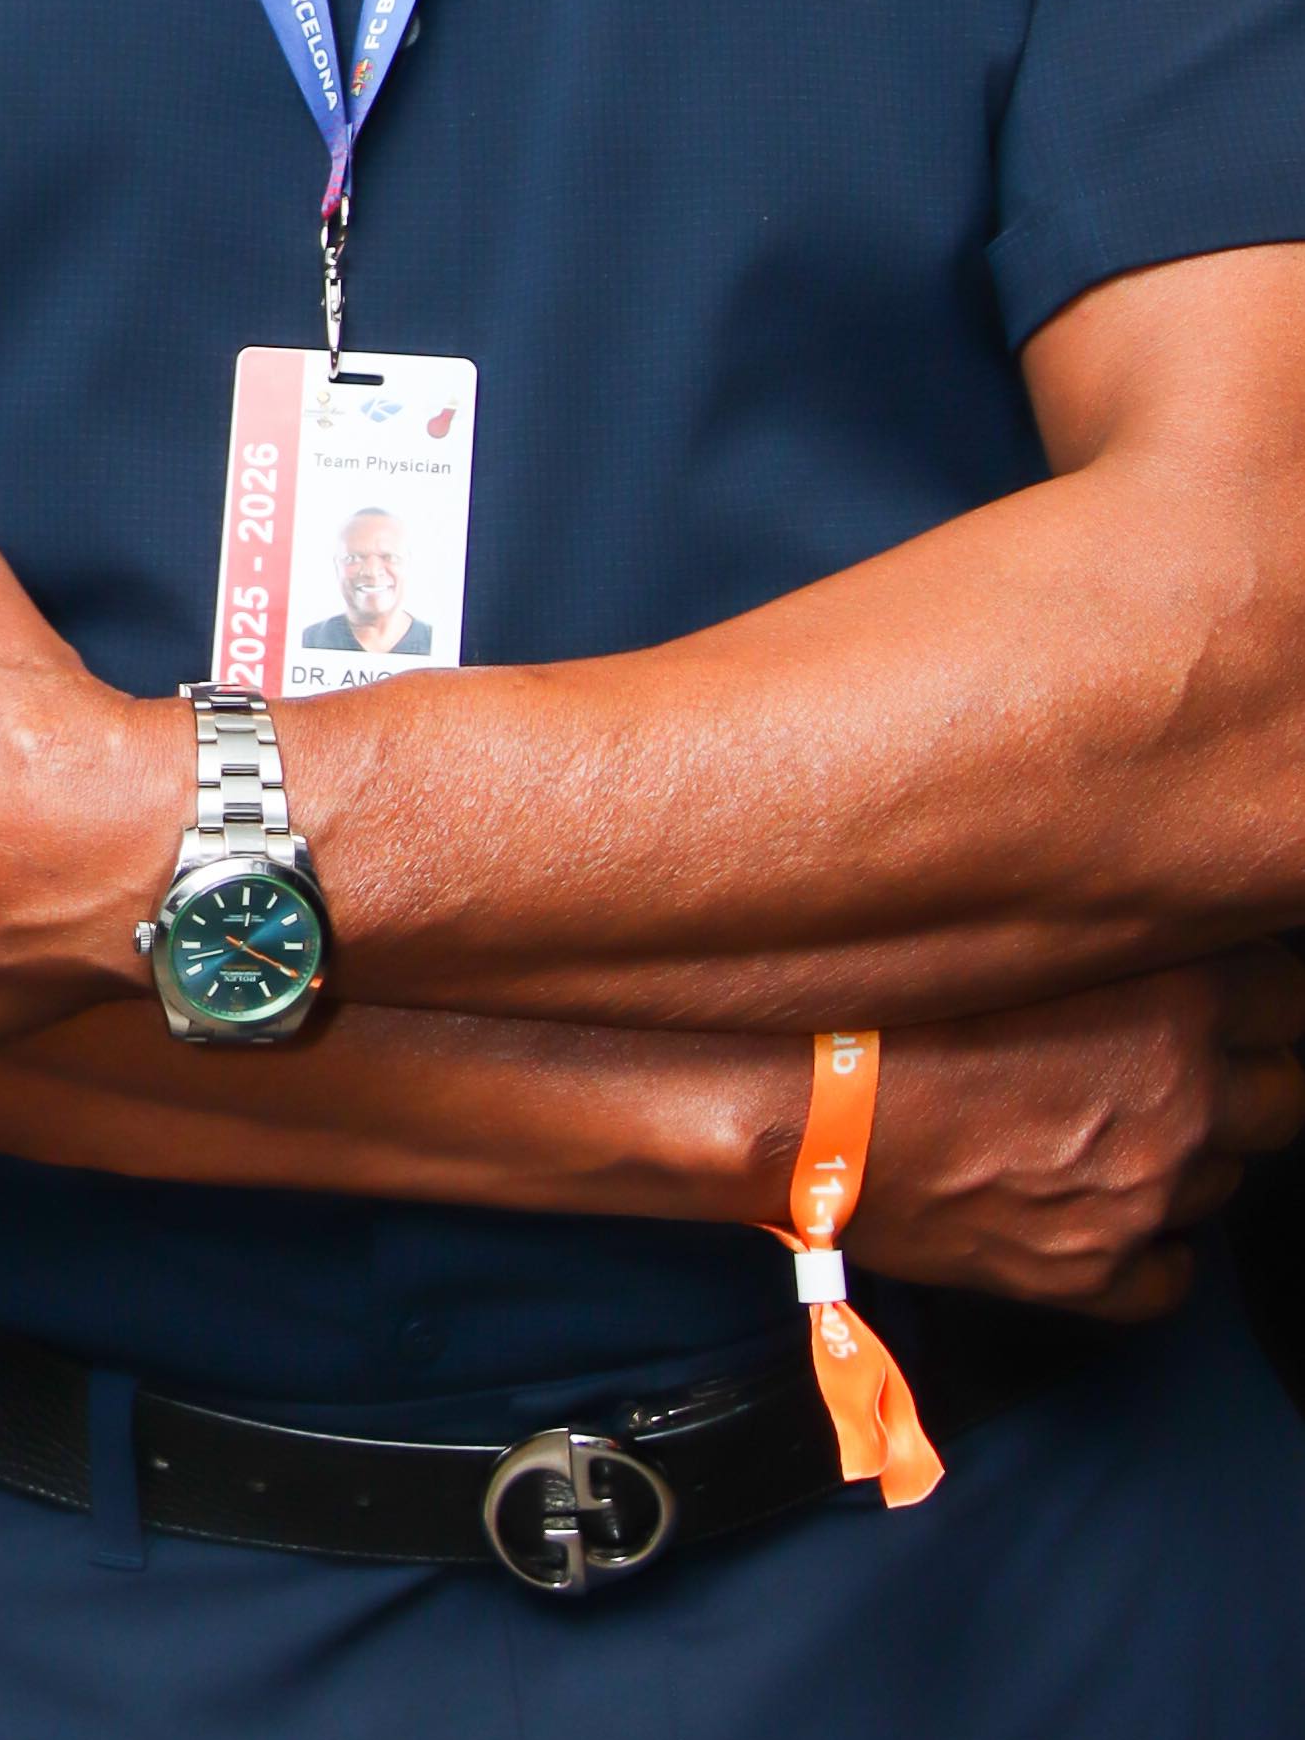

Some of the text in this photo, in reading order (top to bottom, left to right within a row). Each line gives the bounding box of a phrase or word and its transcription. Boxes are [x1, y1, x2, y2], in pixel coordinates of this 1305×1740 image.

[363, 18, 387, 51] FC
[314, 452, 452, 475] Team Physician
[237, 442, 279, 545] 2026
[227, 586, 269, 689] 2025
[291, 666, 331, 686] DR.
